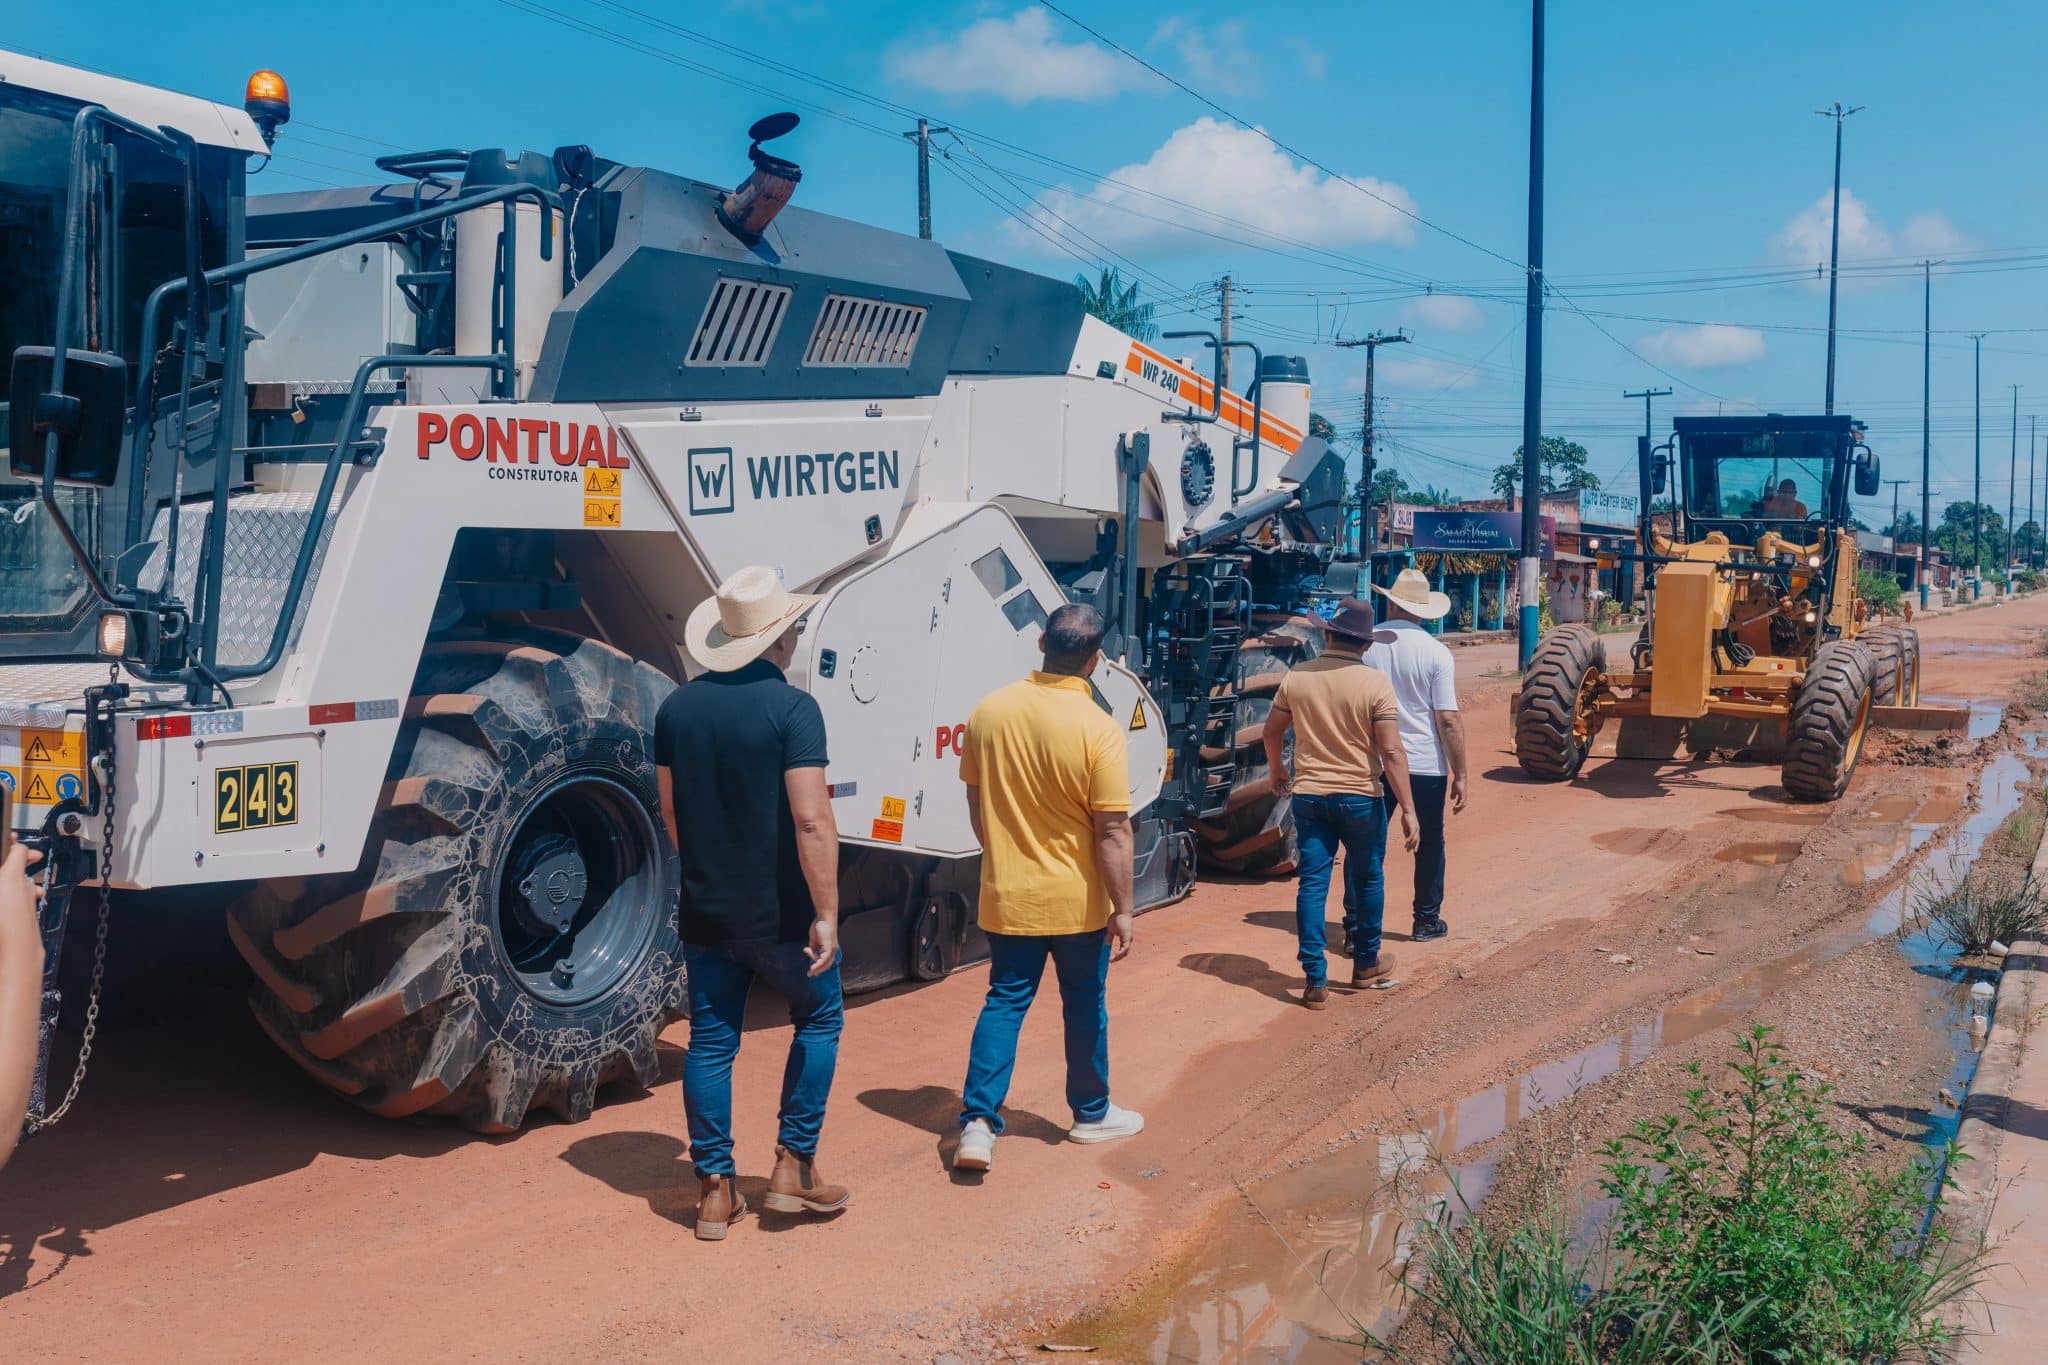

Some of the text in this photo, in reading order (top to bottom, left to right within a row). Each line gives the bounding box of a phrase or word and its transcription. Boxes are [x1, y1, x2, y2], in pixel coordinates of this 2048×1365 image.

[1143, 359, 1179, 394] WR 240
[417, 412, 630, 469] PONTUAL
[488, 467, 578, 483] CONSTRUTORA
[747, 450, 899, 499] WIRTGEN
[221, 771, 293, 823] 243
